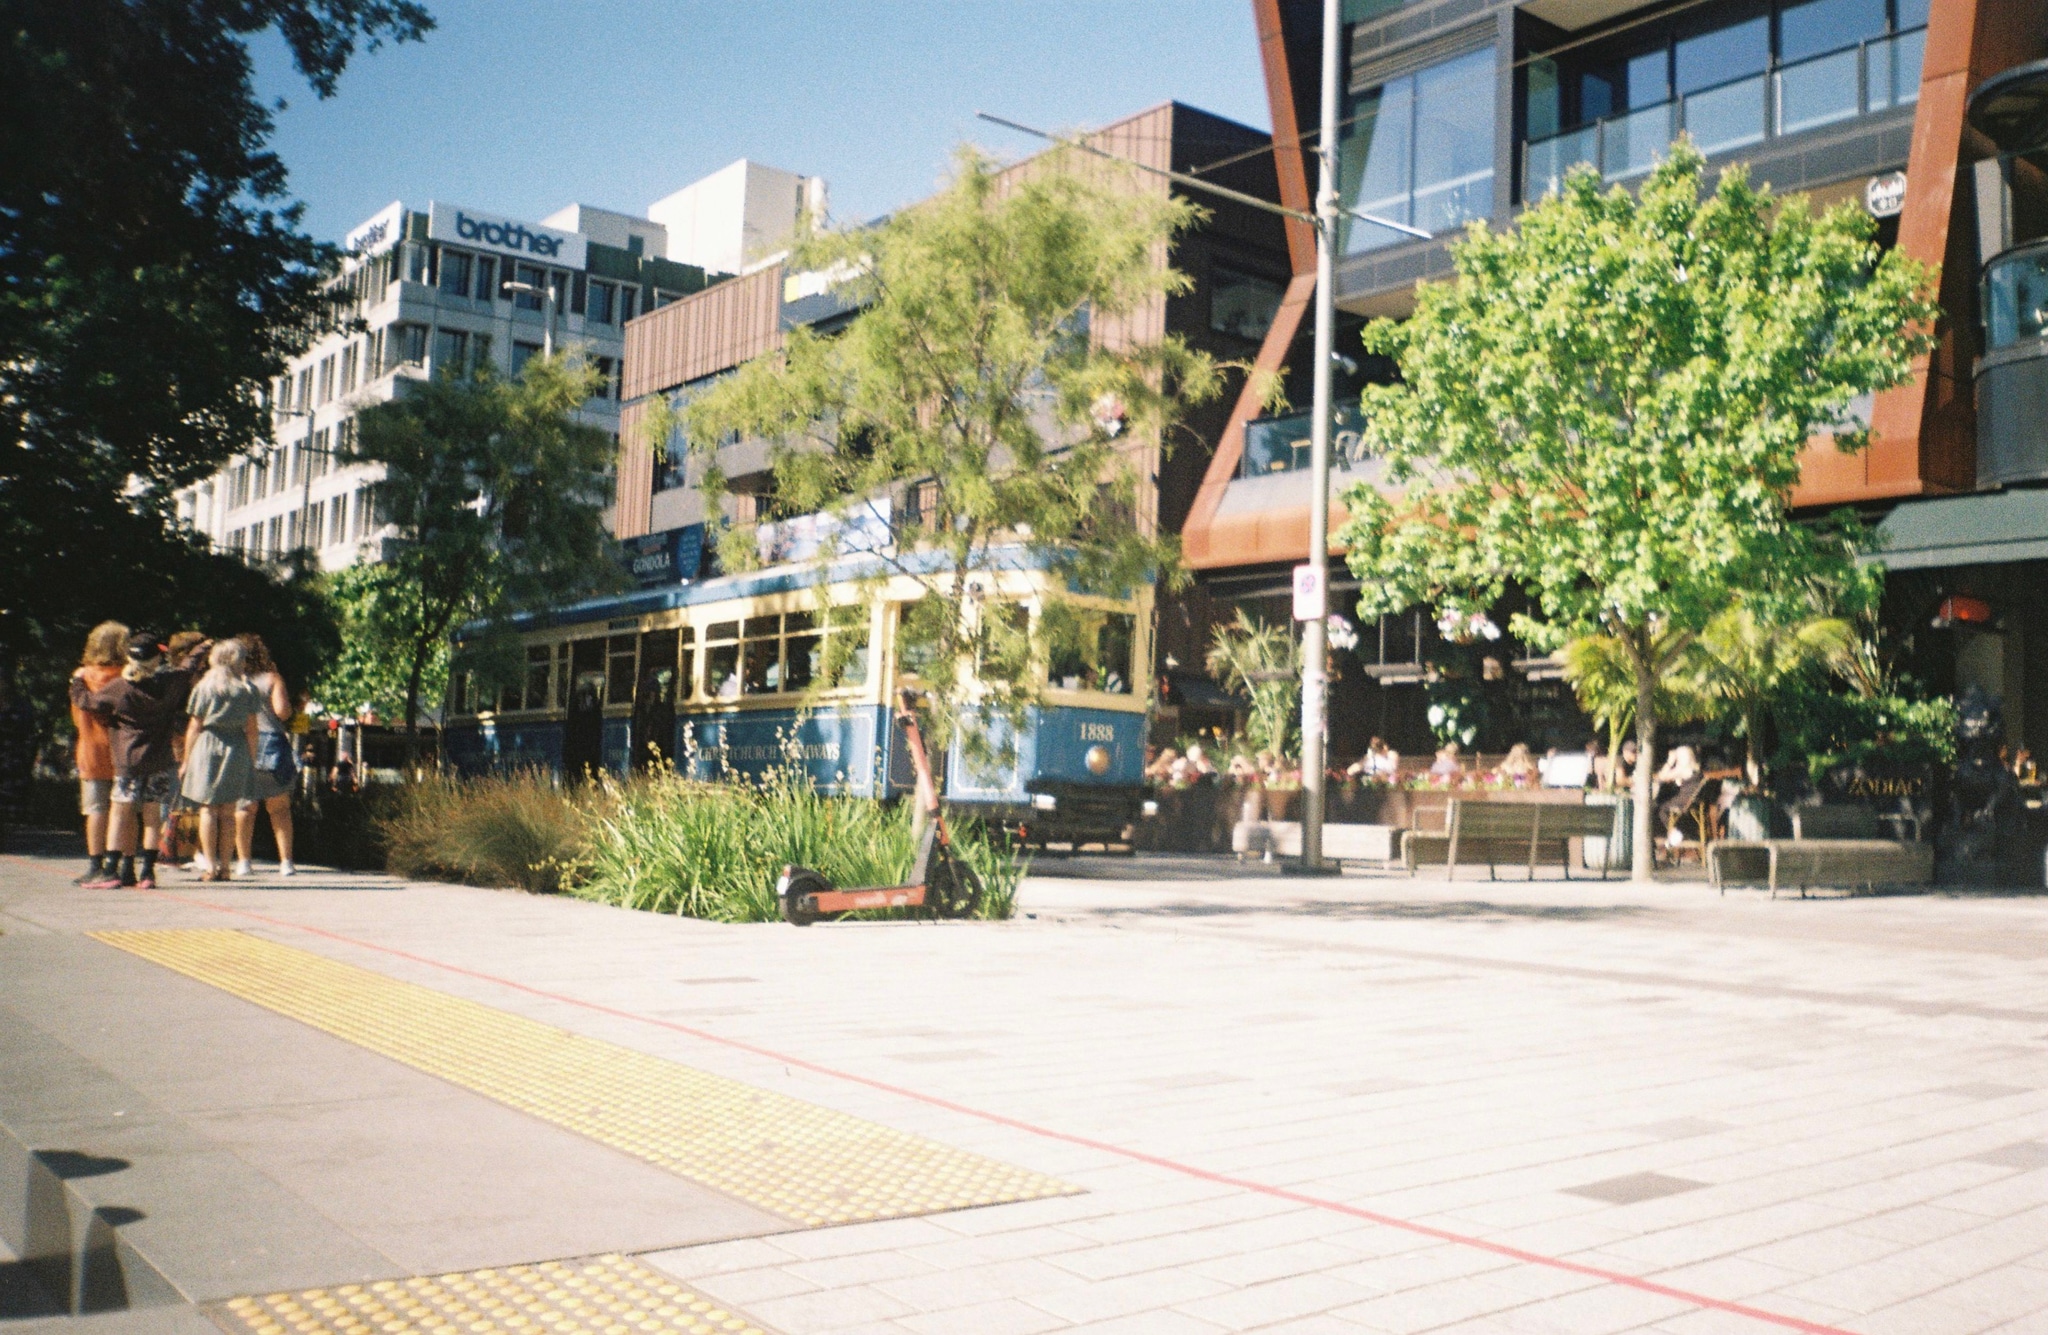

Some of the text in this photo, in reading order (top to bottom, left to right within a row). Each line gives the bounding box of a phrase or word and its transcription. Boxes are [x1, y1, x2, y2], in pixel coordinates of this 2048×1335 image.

[457, 211, 564, 257] brother
[633, 551, 671, 574] GONDOLA
[1081, 722, 1115, 742] 1888
